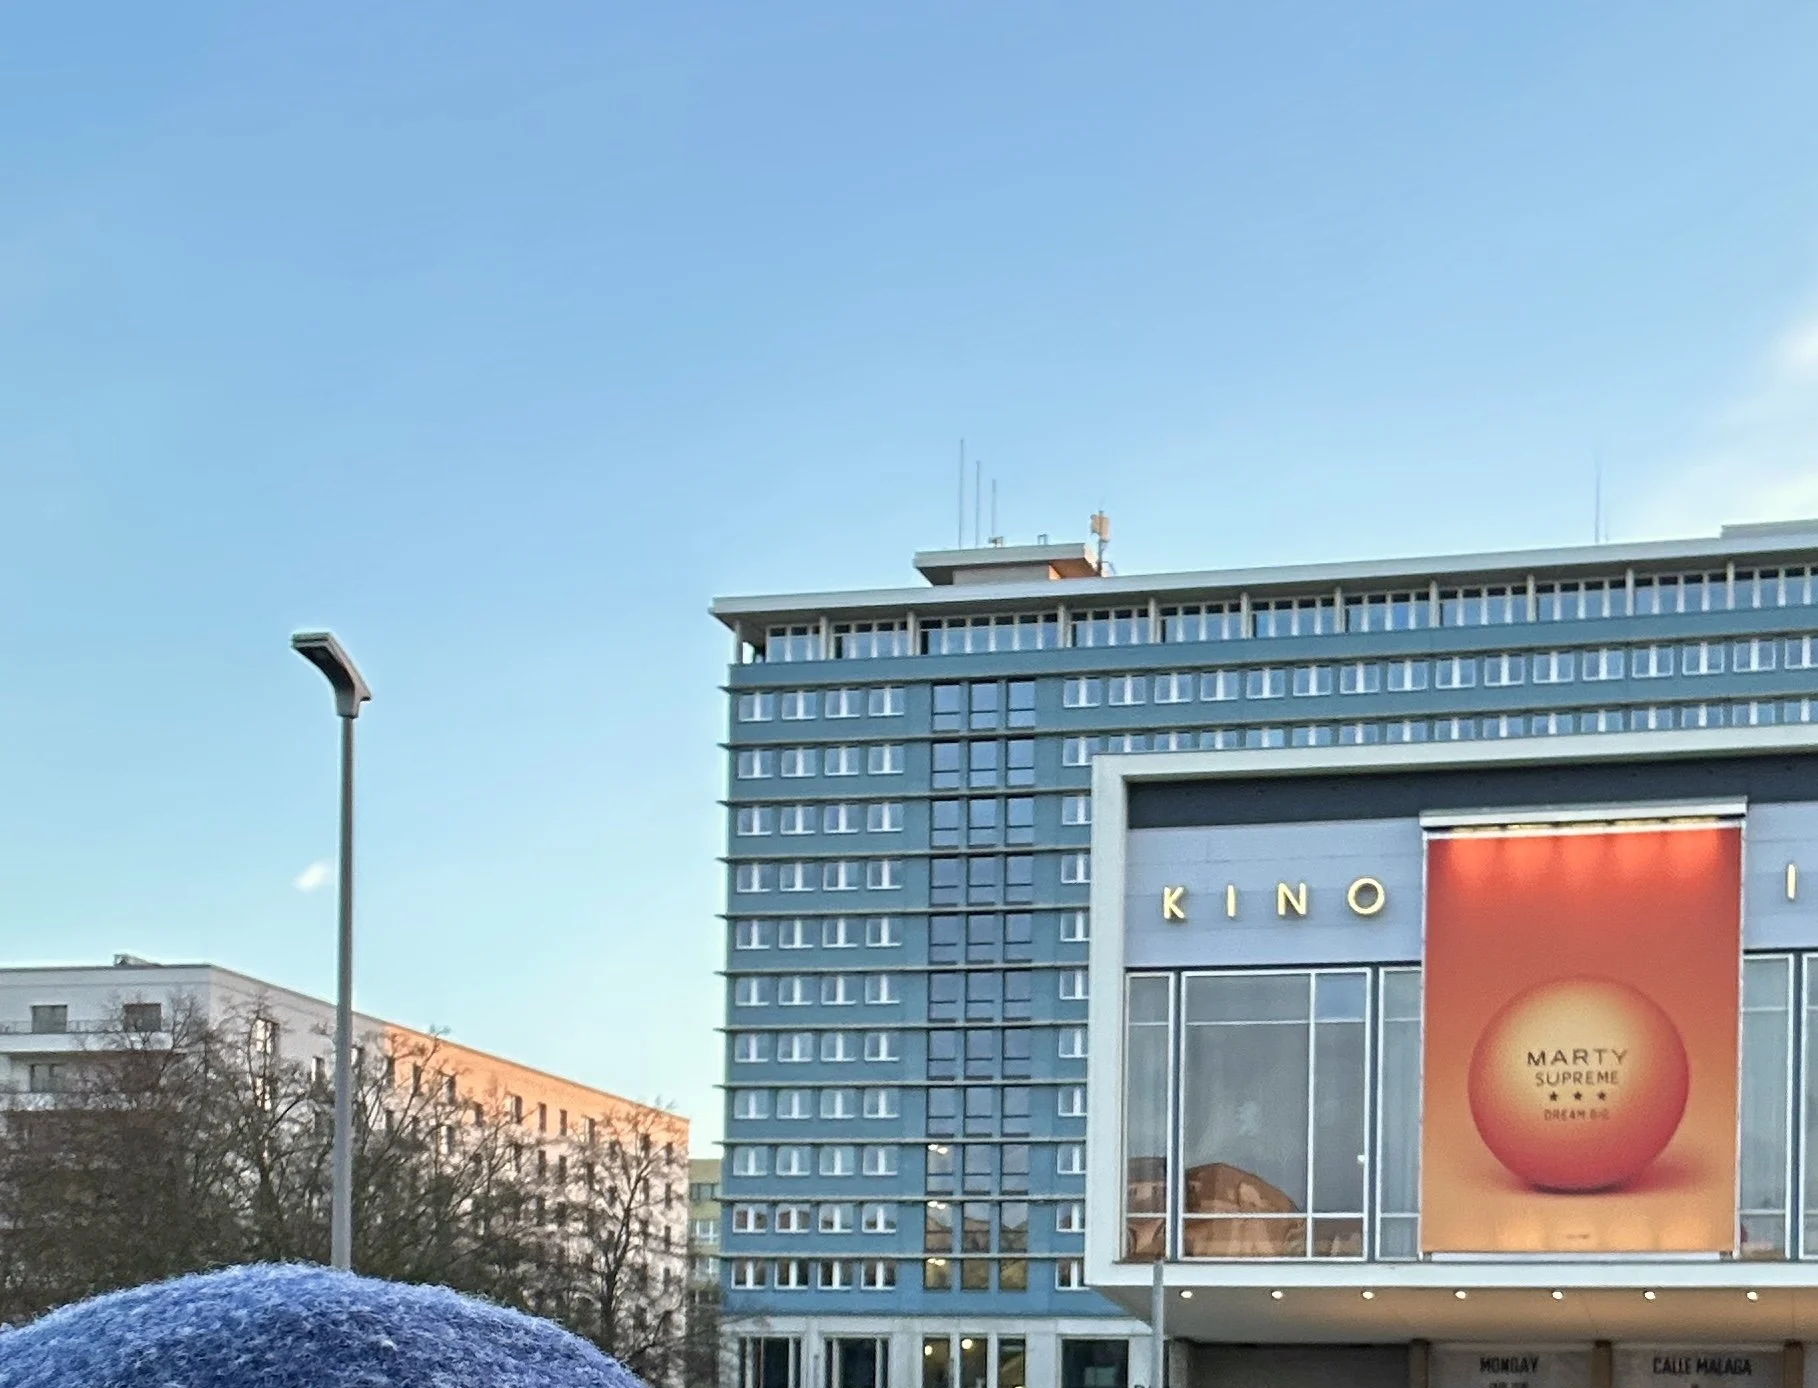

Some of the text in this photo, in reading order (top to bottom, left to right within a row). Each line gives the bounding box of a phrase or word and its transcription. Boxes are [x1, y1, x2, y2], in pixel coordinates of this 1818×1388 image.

[1162, 876, 1386, 920] KINO
[1526, 1048, 1628, 1067] MARTY
[1534, 1070, 1620, 1087] SUPREME
[1543, 1108, 1586, 1121] DREAM
[1479, 1355, 1540, 1374] MONDAY
[1653, 1356, 1692, 1375] CALLE
